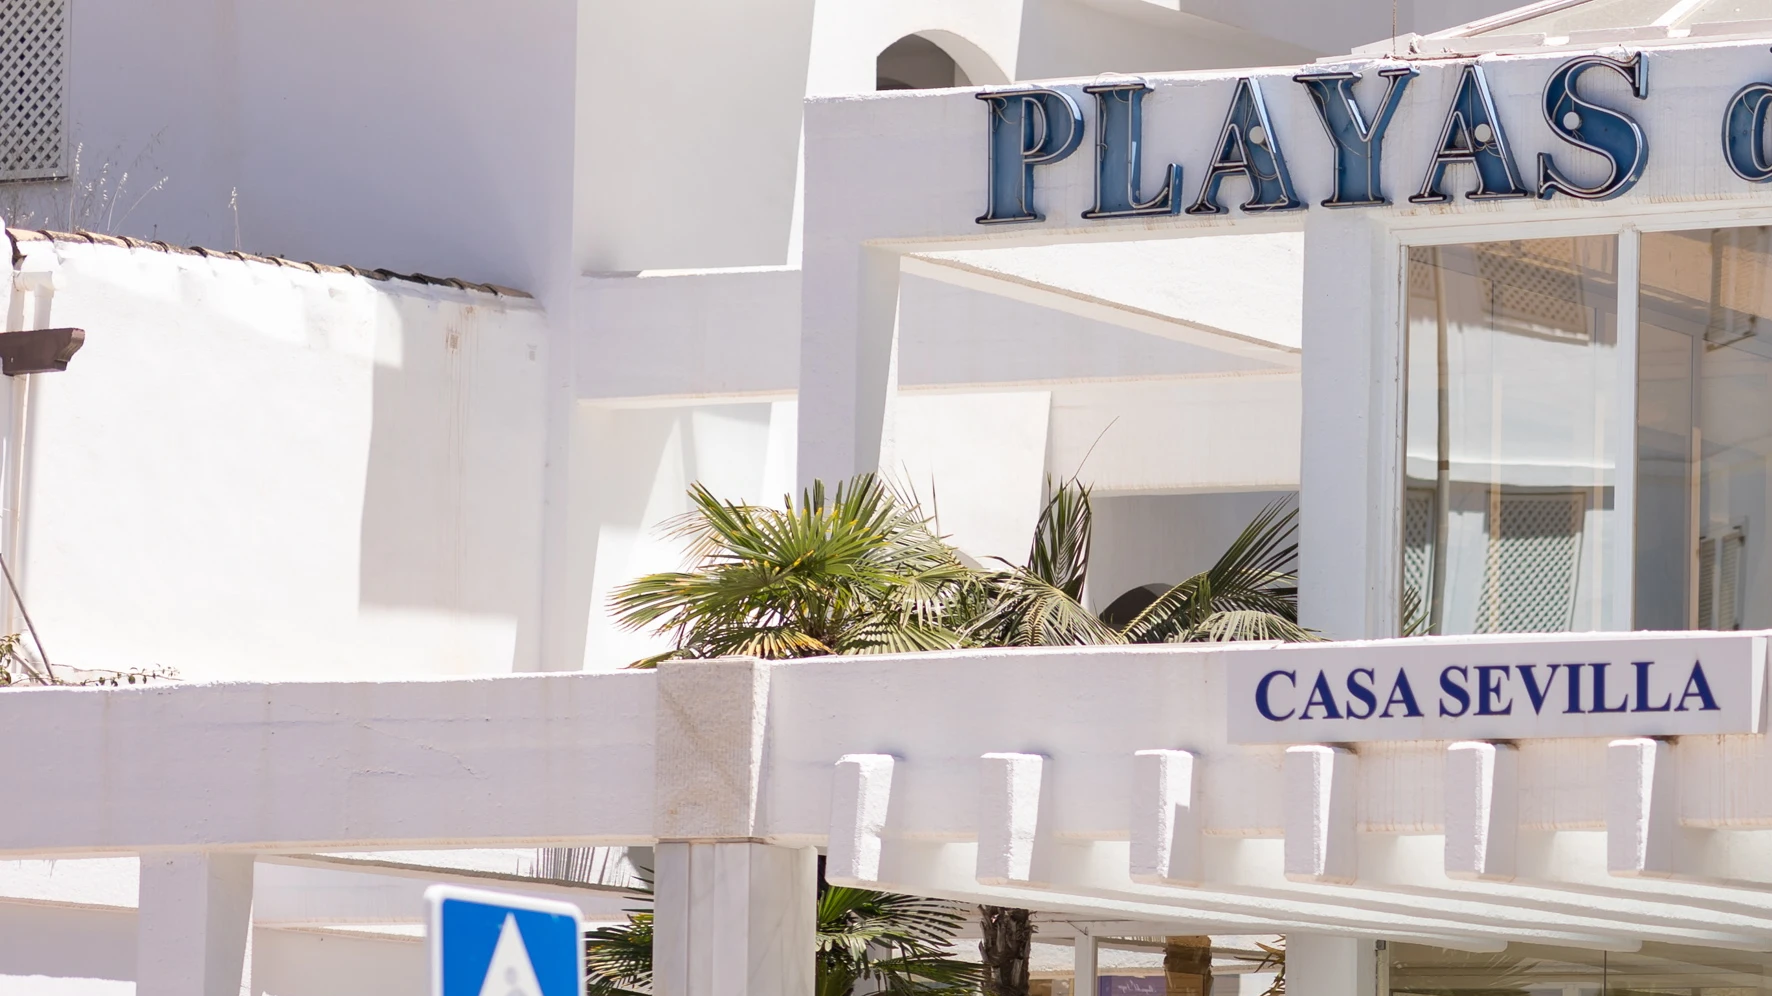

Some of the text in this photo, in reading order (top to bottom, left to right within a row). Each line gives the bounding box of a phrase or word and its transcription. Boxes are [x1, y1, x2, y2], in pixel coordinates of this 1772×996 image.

[976, 51, 1650, 225] PLAYAS
[1255, 659, 1721, 722] CASA SEVILLA
